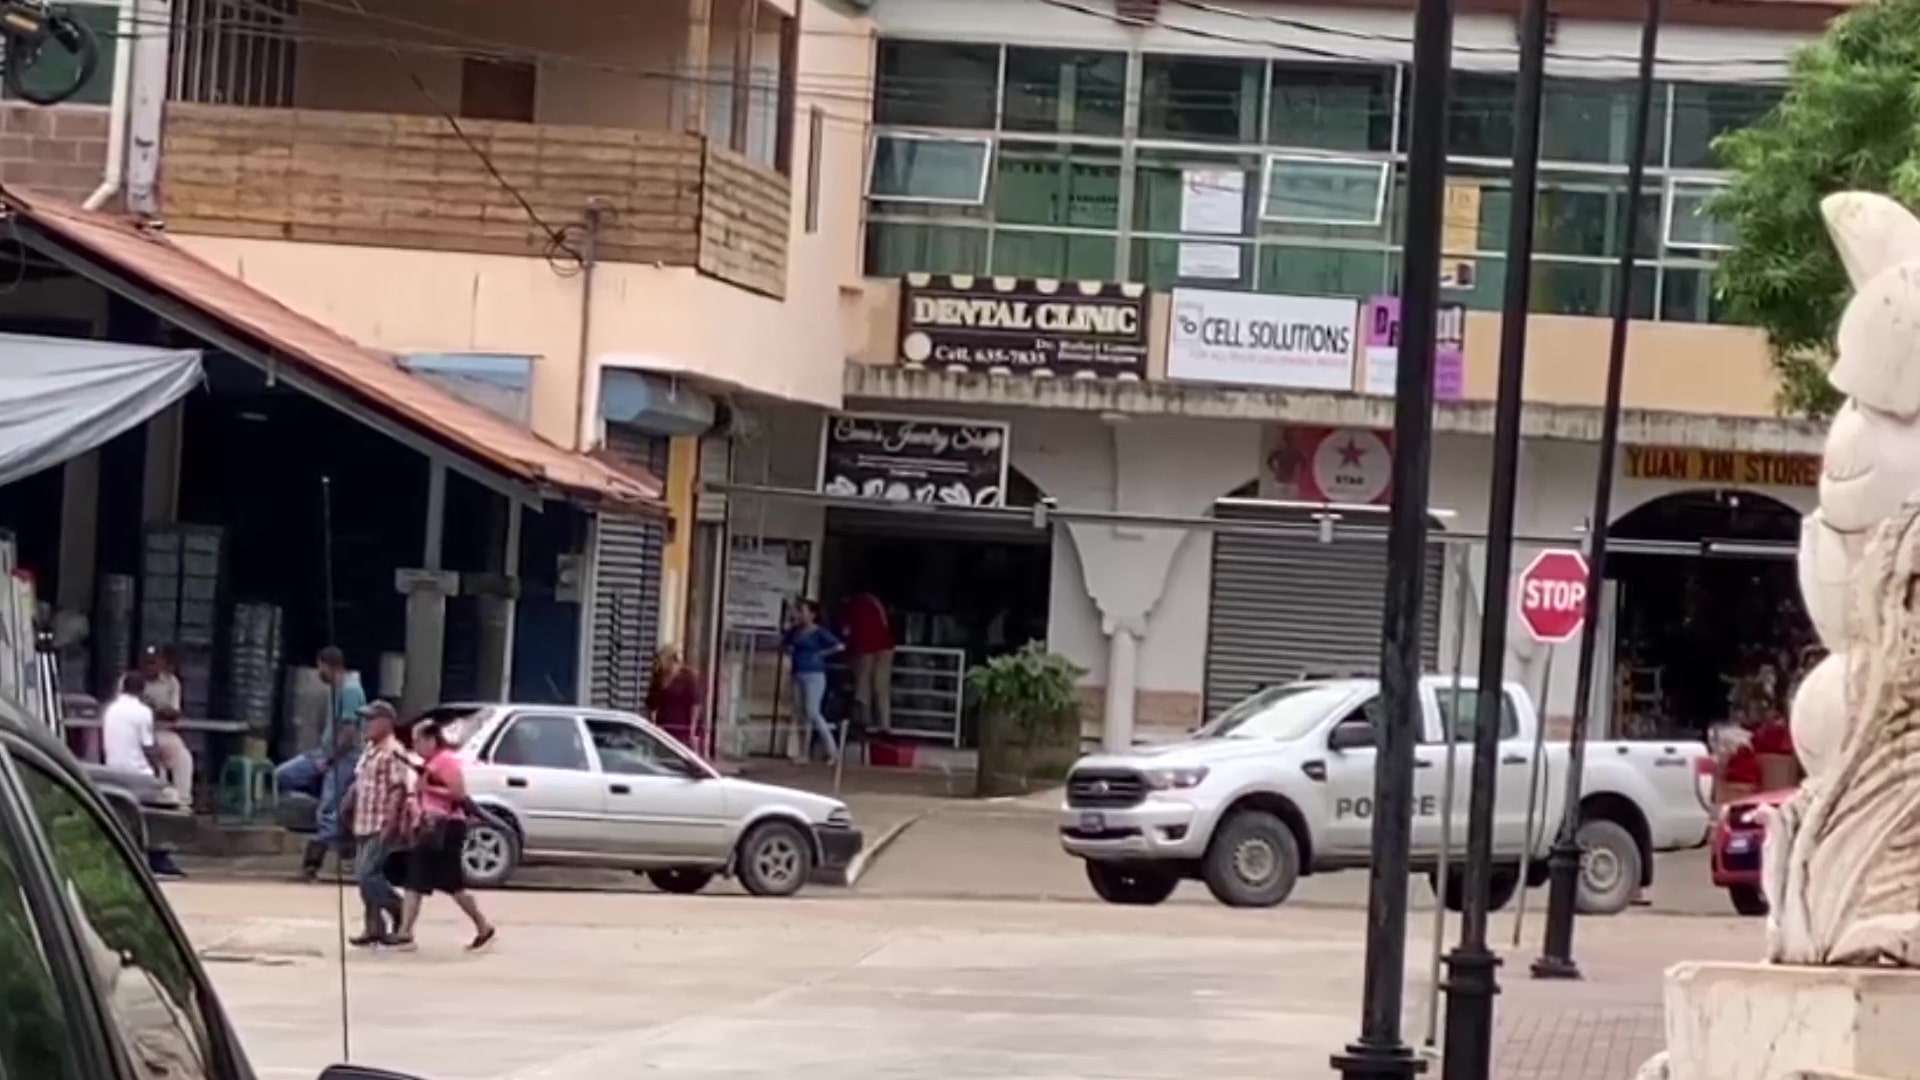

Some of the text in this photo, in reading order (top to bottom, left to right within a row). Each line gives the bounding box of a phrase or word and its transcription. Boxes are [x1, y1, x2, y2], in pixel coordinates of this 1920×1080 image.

[913, 297, 1137, 333] DENTAL CLINIC
[1202, 316, 1350, 354] CELL SOLUTIONS
[1629, 447, 1819, 487] YUAN XIN STORE
[1526, 578, 1586, 611] STOP
[1336, 795, 1436, 820] POE
